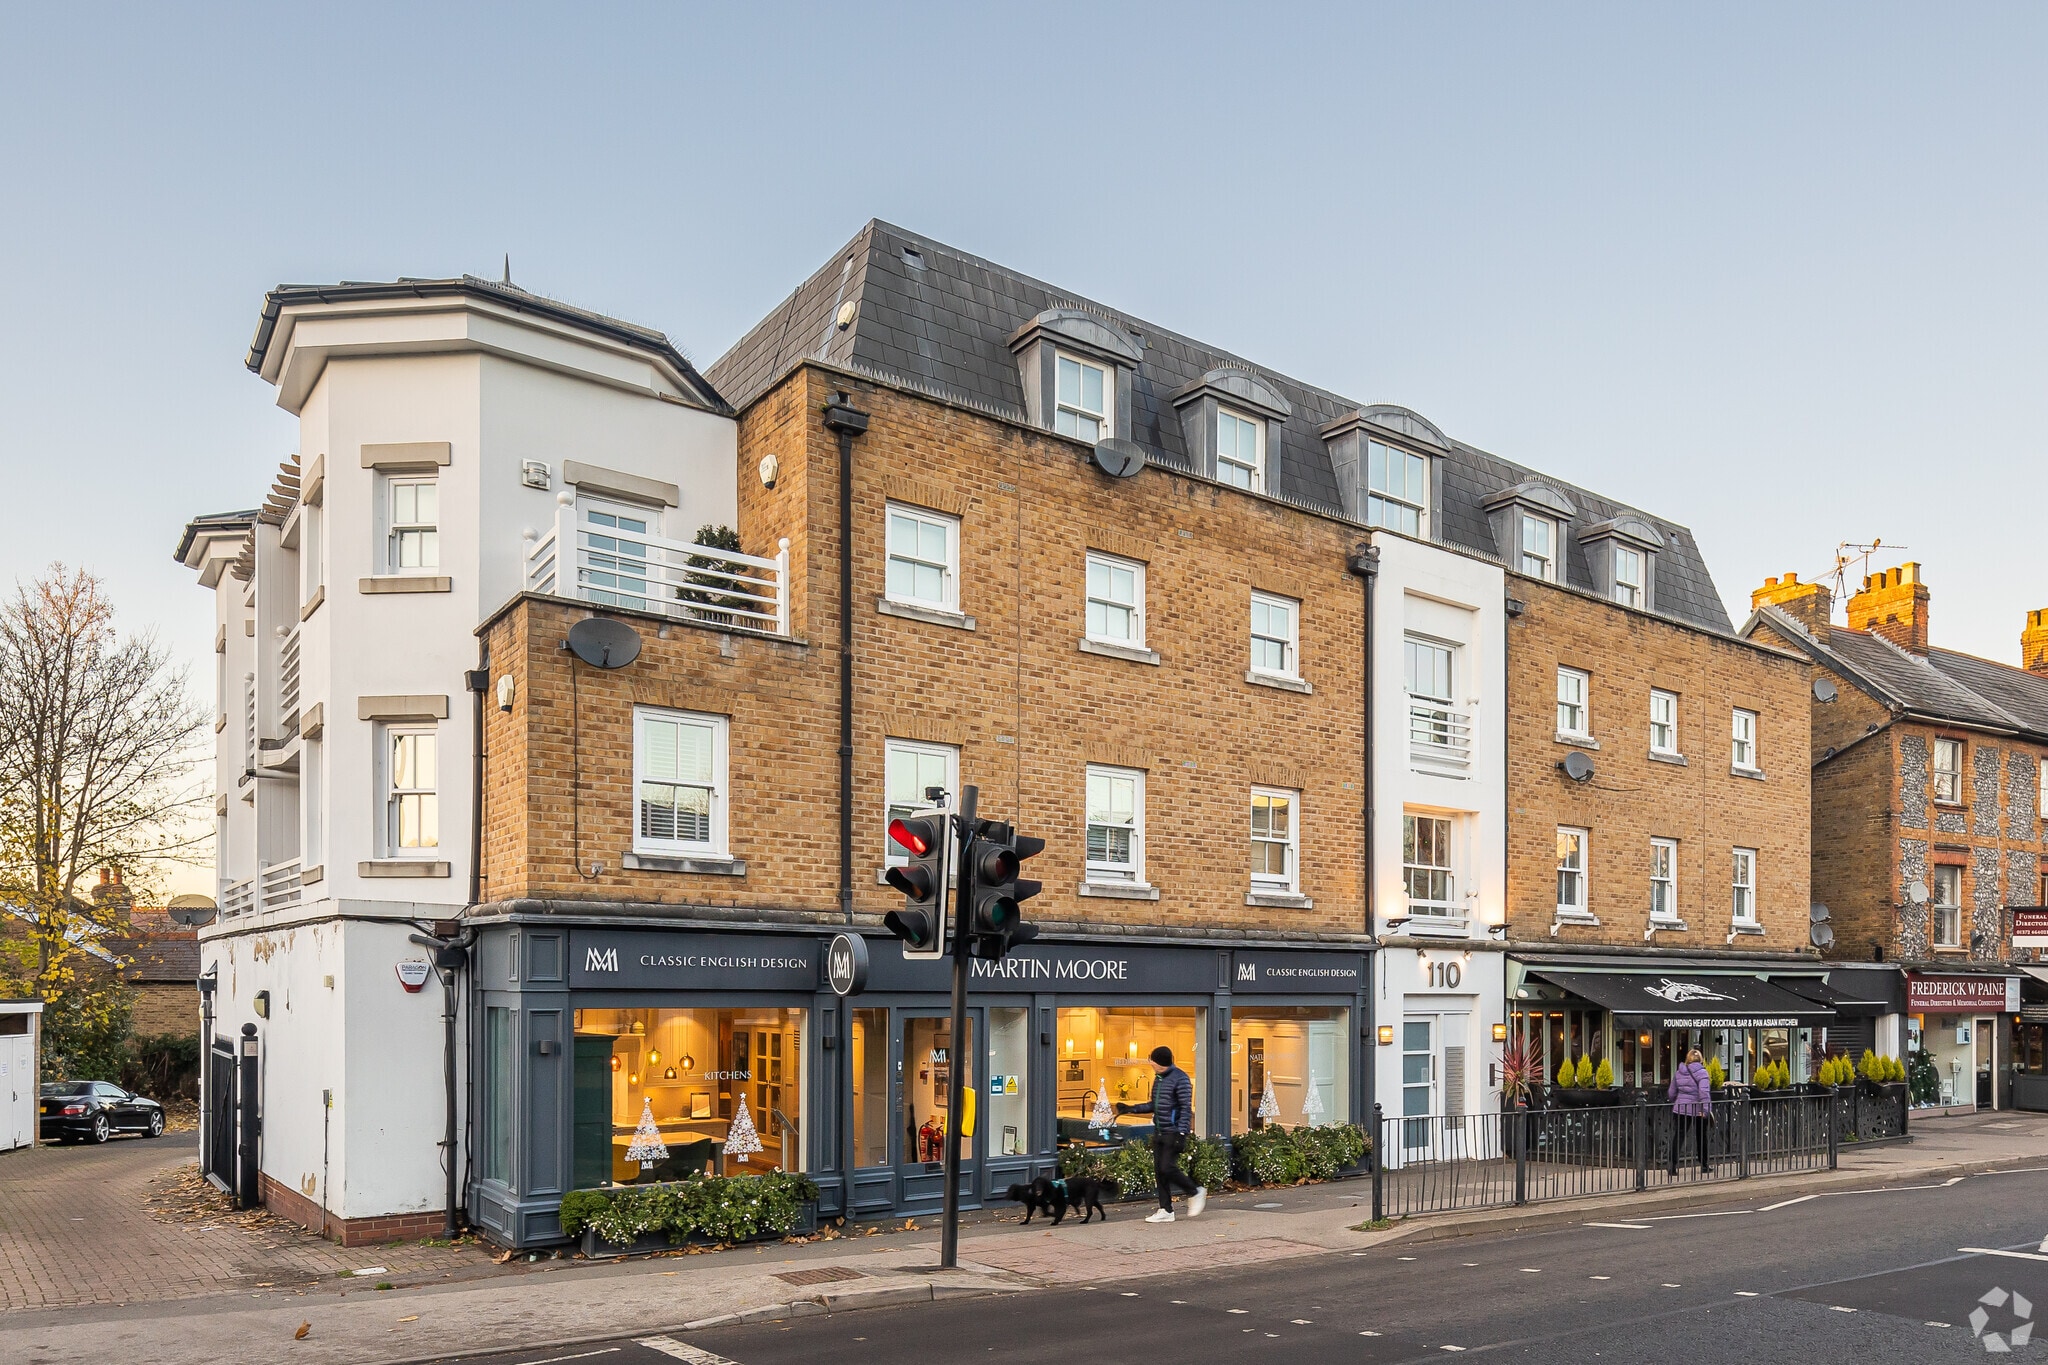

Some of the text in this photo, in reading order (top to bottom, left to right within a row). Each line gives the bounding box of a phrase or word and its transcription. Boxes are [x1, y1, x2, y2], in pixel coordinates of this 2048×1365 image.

[640, 954, 808, 969] CLASSIC ENGLISH DESIGN
[971, 958, 1127, 980] MARTIN MOORE
[1266, 967, 1357, 978] CLASSIC ENGLISH DESIGN
[1427, 961, 1461, 988] 110
[1911, 981, 2004, 996] FREDERICK W PAINE
[1664, 1019, 1692, 1027] POUNDING
[1693, 1019, 1710, 1027] HEART
[1711, 1019, 1736, 1027] COCKTAIL
[1779, 1018, 1798, 1026] KITCHEN
[704, 1070, 752, 1080] KITCHENS
